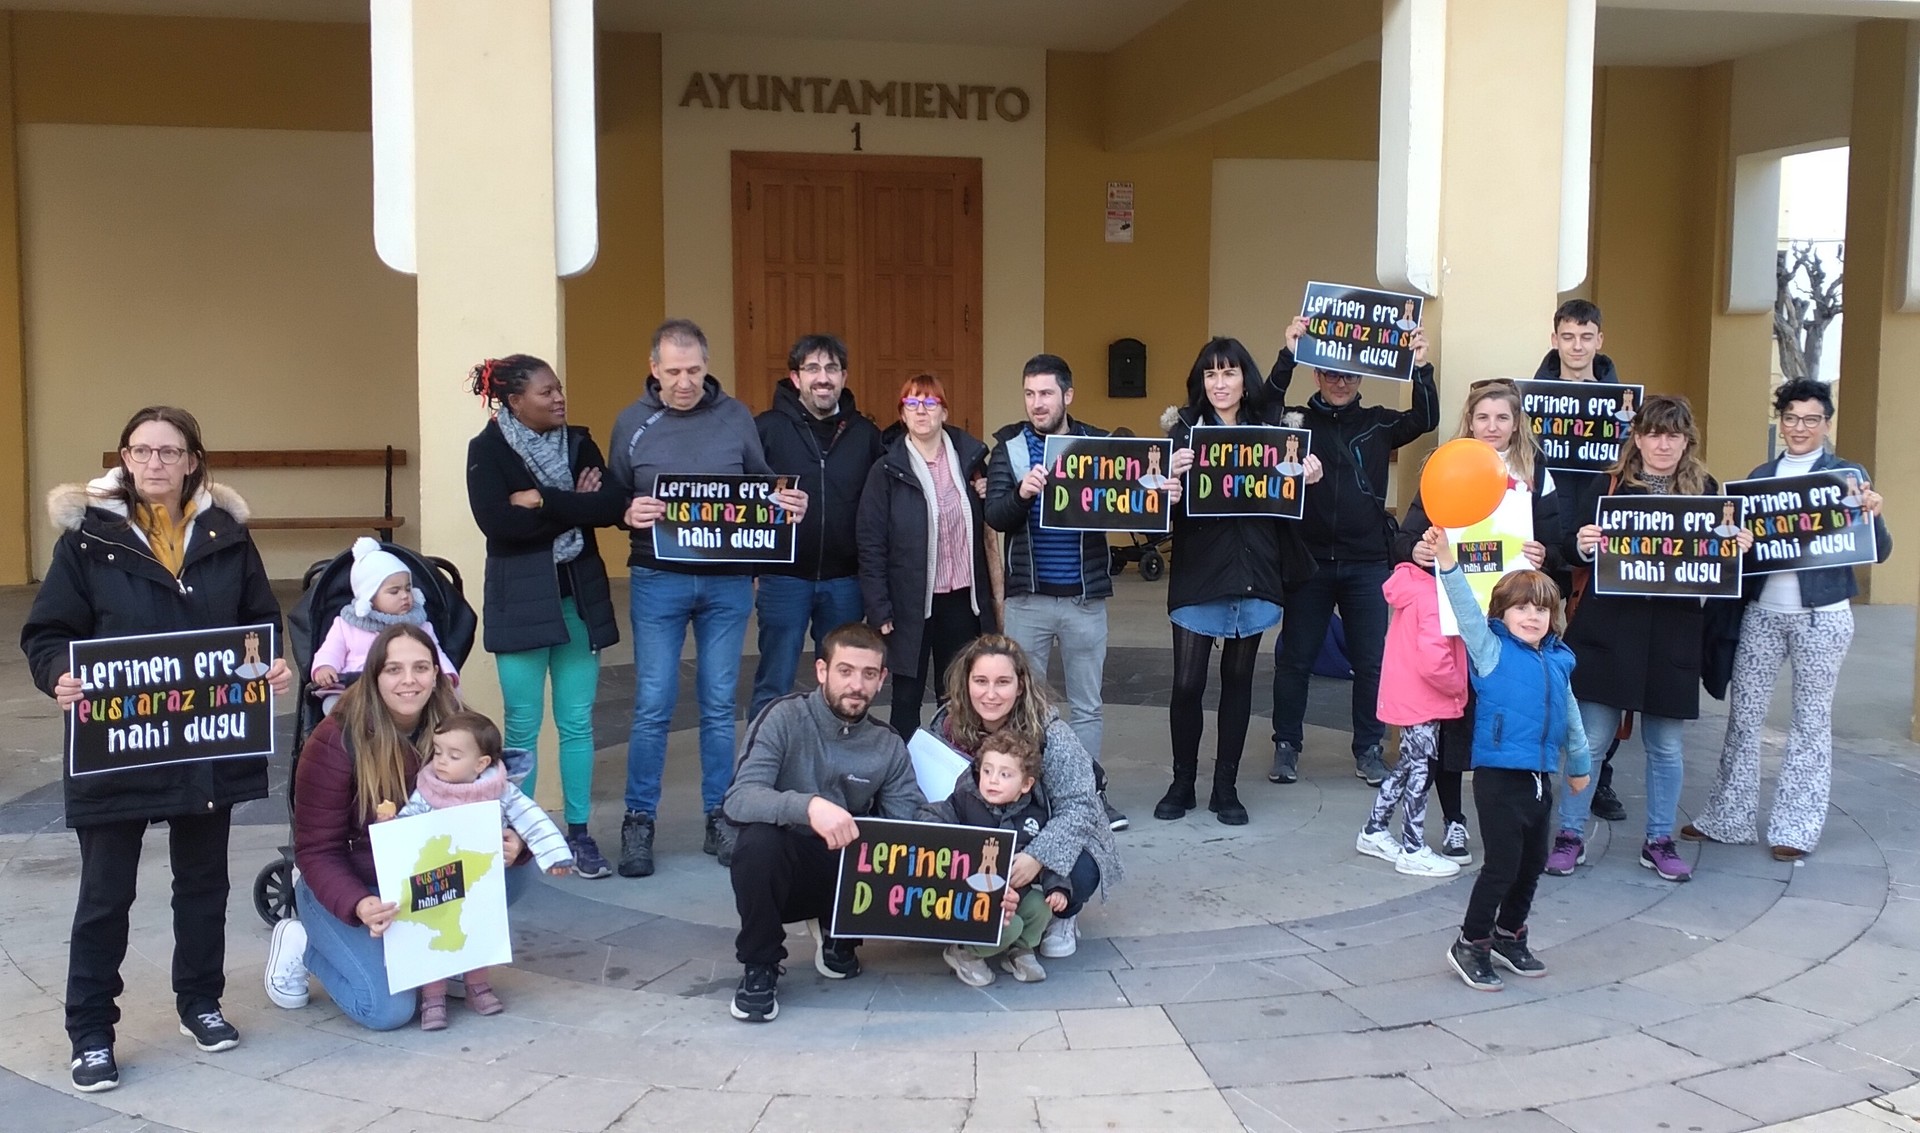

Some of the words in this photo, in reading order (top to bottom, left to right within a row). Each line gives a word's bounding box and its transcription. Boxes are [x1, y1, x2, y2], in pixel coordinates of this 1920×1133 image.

[679, 71, 1031, 123] AYUNTAMIENTO
[851, 122, 863, 151] 1
[1373, 304, 1399, 325] ere
[1315, 339, 1352, 361] nahi
[1360, 345, 1399, 369] dugu
[1522, 394, 1580, 415] erinen
[1588, 397, 1616, 417] ere
[1530, 416, 1595, 438] skaraz
[1199, 443, 1278, 467] Lerinen
[1543, 439, 1570, 459] ahi
[1578, 441, 1620, 462] dugu
[1055, 454, 1141, 480] Lerinen
[739, 481, 769, 500] ere
[1054, 485, 1069, 512] D
[1081, 486, 1159, 514] eredua
[1199, 473, 1212, 499] D
[1222, 474, 1295, 500] eredua
[665, 501, 747, 524] uskaraz
[1743, 491, 1802, 515] erinen
[1809, 485, 1842, 507] ere
[1683, 511, 1716, 532] ere
[677, 527, 721, 548] nahi
[730, 527, 776, 549] dugu
[1600, 535, 1684, 556] euskaraz
[1693, 538, 1737, 557] ikasi
[1755, 537, 1801, 561] nahi
[1809, 532, 1856, 555] dugu
[1620, 560, 1665, 582] nahi
[1674, 560, 1721, 584] dugu
[194, 648, 235, 680] ere
[78, 689, 196, 724] euskaraz
[209, 679, 266, 708] ikasi
[108, 720, 170, 753] nahi
[184, 711, 246, 744] dugu
[857, 842, 970, 880] Lerinen
[852, 881, 873, 915] D
[888, 884, 991, 923] eredua
